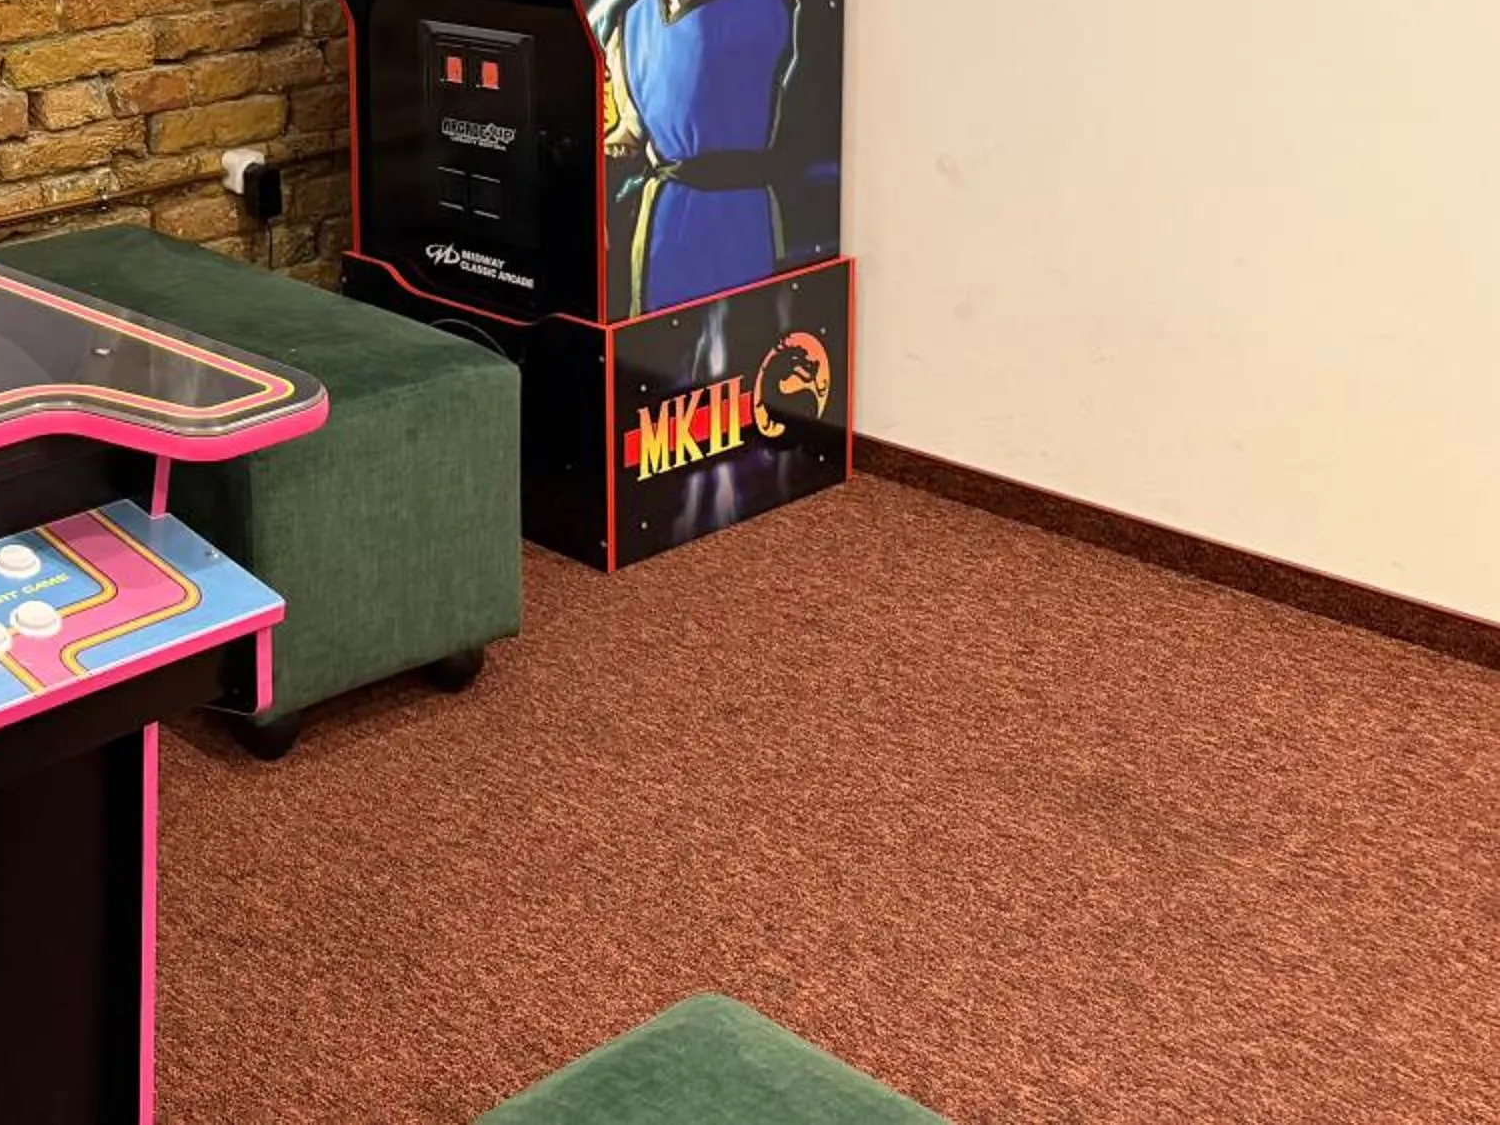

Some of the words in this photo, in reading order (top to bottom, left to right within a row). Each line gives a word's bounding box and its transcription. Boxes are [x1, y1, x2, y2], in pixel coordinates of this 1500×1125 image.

[461, 249, 505, 270] MIDWAY
[460, 260, 497, 278] CLASSIC
[498, 270, 534, 289] ARCADE
[637, 375, 744, 481] MKII
[21, 573, 69, 595] GAME
